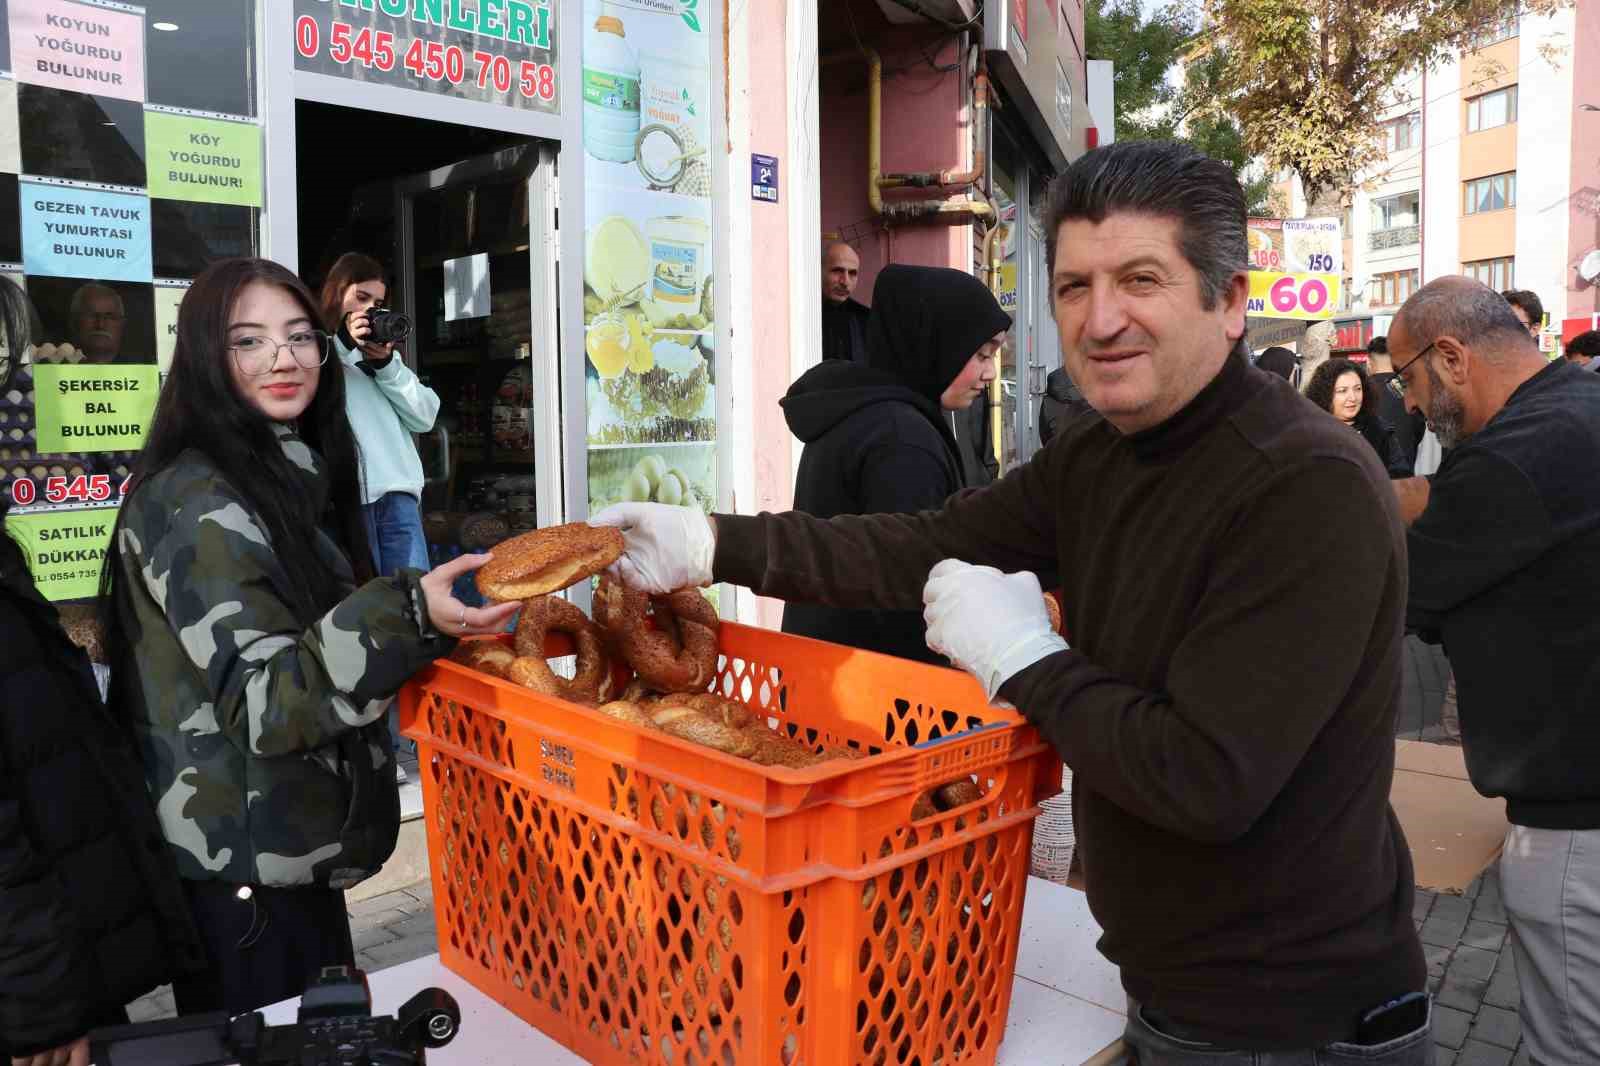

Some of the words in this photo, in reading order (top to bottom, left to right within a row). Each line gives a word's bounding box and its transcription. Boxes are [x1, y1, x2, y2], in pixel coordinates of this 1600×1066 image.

[46, 14, 110, 36] KOYUN
[35, 35, 122, 61] YOĞURDU
[296, 16, 319, 57] 0
[330, 22, 394, 71] 545
[404, 38, 464, 84] 450
[474, 51, 511, 92] 70
[520, 60, 554, 99] 58
[37, 60, 122, 85] BULUNUR
[189, 133, 220, 147] KÖY
[170, 150, 241, 168] YOĞURDU
[169, 171, 242, 188] BULUNUR!
[34, 201, 85, 215] GEZEN
[90, 206, 141, 220] TAVUK
[44, 222, 132, 240] YUMURTASI
[53, 244, 126, 259] BULUNUR
[1254, 250, 1279, 267] 180
[1308, 254, 1333, 271] 150
[1270, 277, 1328, 313] 60
[59, 376, 139, 395] ŞEKERSİZ
[85, 402, 117, 414] BAL
[61, 424, 141, 437] BULUNUR
[12, 478, 35, 504] 0
[46, 474, 110, 502] 545
[40, 525, 106, 541] SATILIK
[50, 571, 76, 582] 0554
[79, 569, 97, 579] 735
